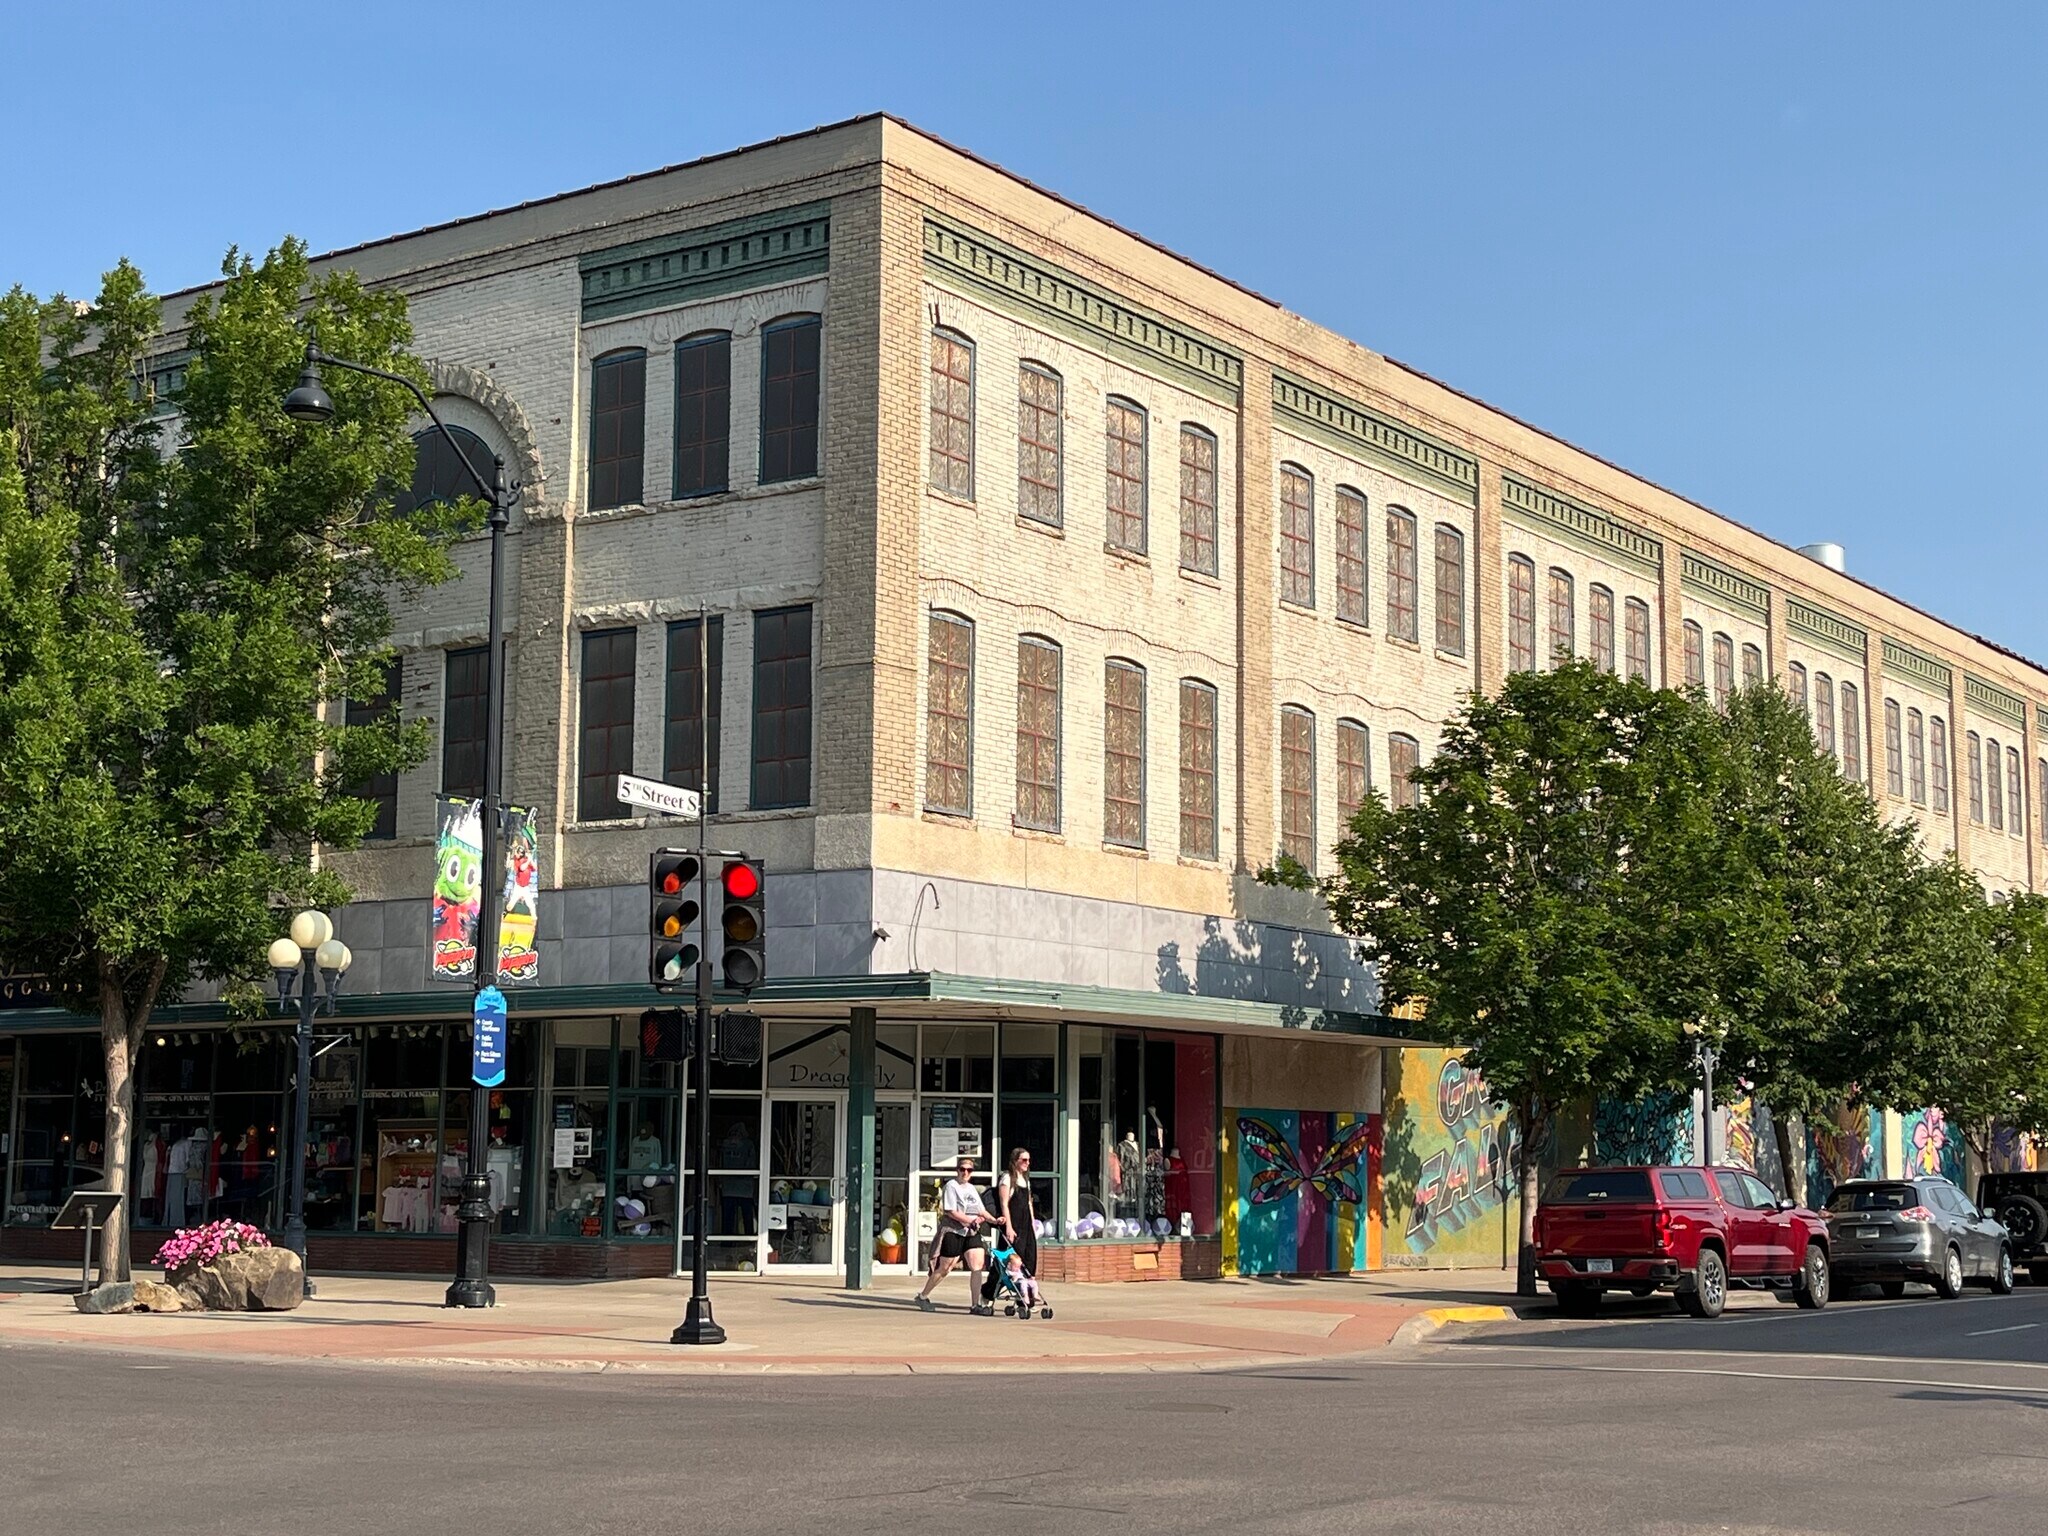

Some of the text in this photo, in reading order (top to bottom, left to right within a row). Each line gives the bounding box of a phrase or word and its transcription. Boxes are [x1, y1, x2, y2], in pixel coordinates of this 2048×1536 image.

[621, 781, 697, 811] 5TH Street S
[788, 1064, 897, 1089] Dragly
